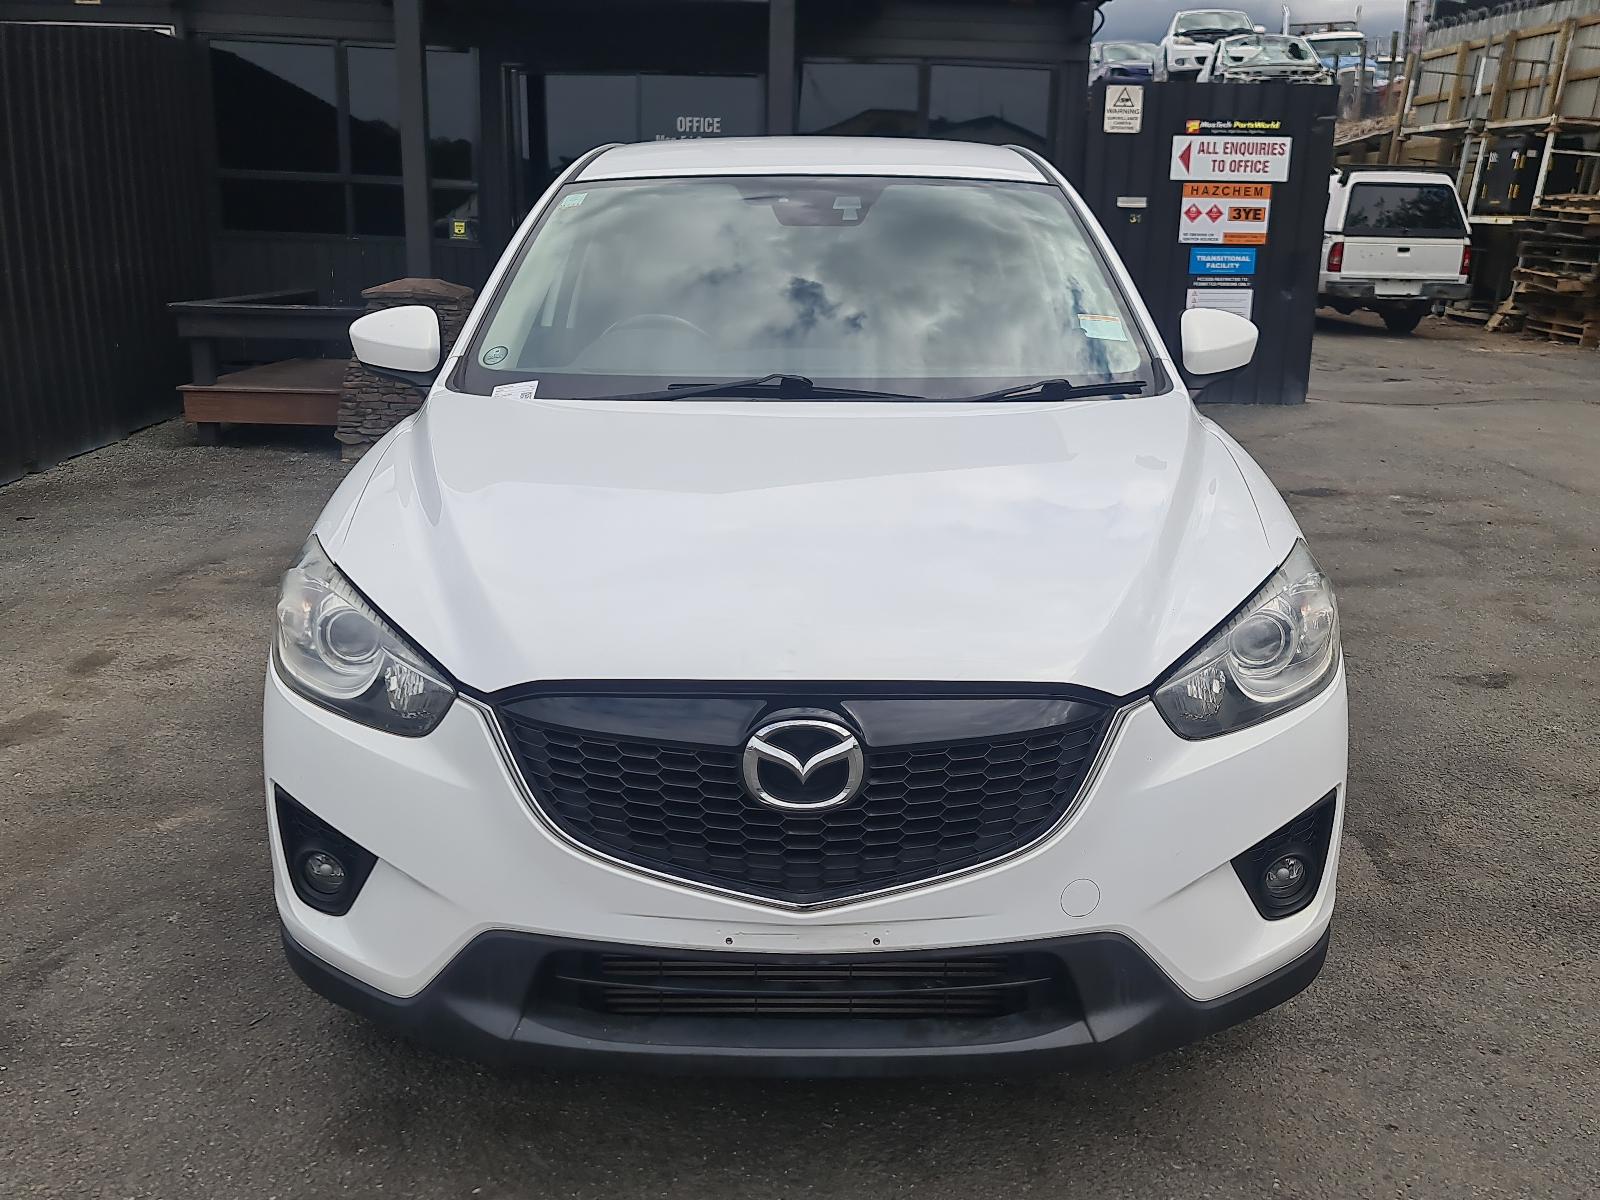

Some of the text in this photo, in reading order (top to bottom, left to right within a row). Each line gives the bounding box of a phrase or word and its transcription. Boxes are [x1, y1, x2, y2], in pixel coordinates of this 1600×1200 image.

[676, 116, 721, 133] OFFICE
[1197, 141, 1287, 156] ALL ENQUIRIES
[1211, 160, 1270, 173] TO OFFICE
[1190, 186, 1264, 197] HAZCHEM
[1232, 208, 1262, 221] 3YE
